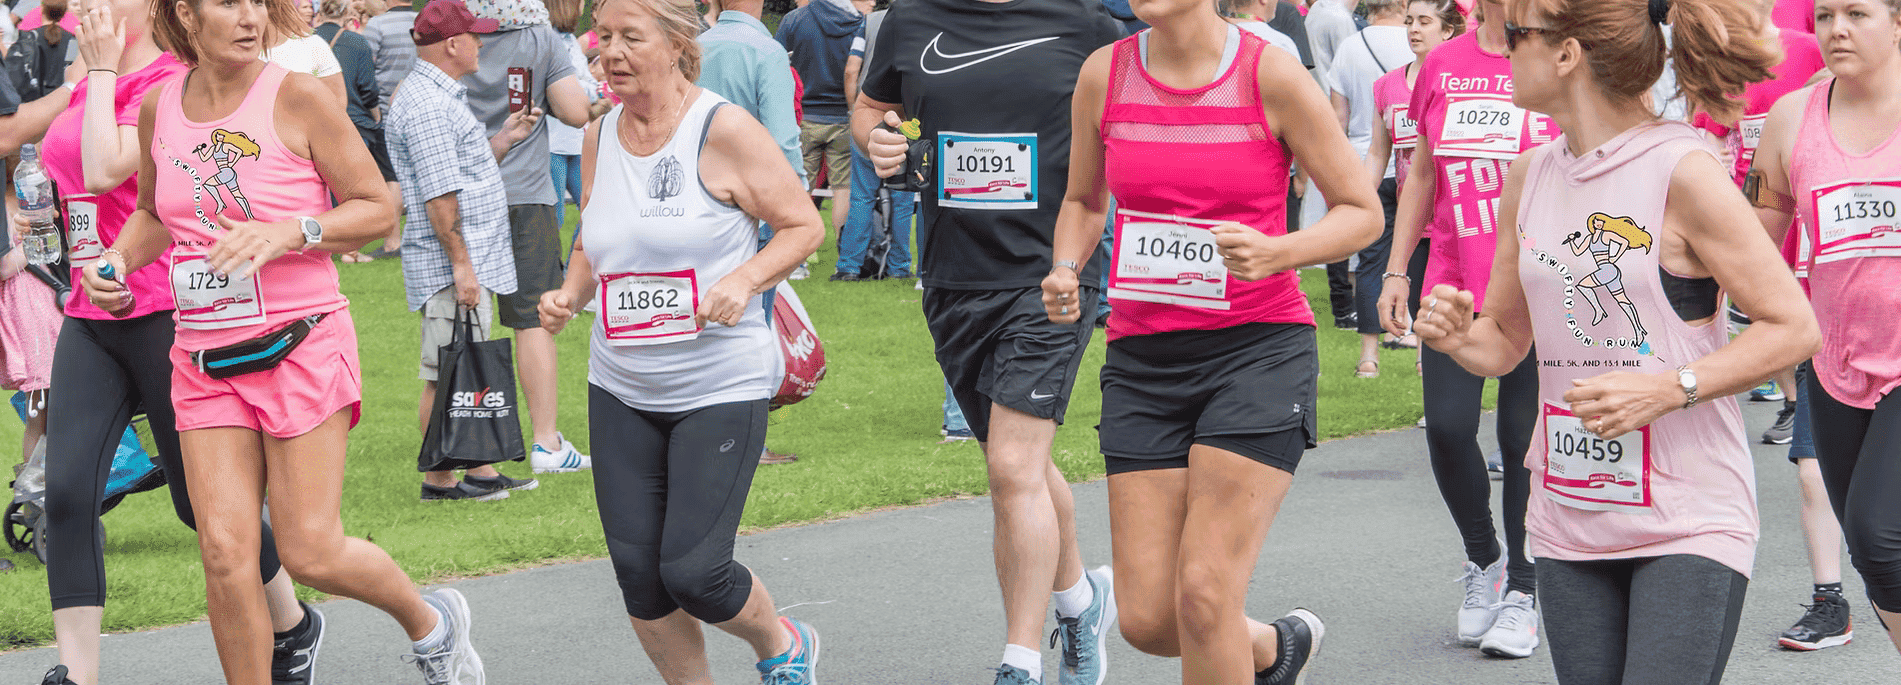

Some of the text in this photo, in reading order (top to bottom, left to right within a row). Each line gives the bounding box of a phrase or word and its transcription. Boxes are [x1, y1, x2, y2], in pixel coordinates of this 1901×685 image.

[1440, 72, 1514, 92] Team Te
[1401, 117, 1418, 127] 10
[1456, 110, 1510, 126] 10278
[1743, 128, 1761, 138] 108
[957, 154, 1015, 173] 10191
[173, 158, 202, 203] SWIFTY
[196, 210, 216, 231] FUN
[640, 205, 684, 217] willow
[1834, 200, 1896, 222] 11330
[70, 214, 90, 231] 899
[1136, 236, 1214, 263] 10460
[189, 272, 230, 290] 1729
[1537, 252, 1574, 307] SWIFTY
[618, 289, 678, 310] 11862
[1567, 319, 1593, 346] FUN
[1605, 337, 1641, 349] RUN
[1582, 360, 1600, 368] AND
[1622, 360, 1642, 368] MILE
[1574, 426, 1594, 436] Haze
[1554, 431, 1623, 463] 10459
